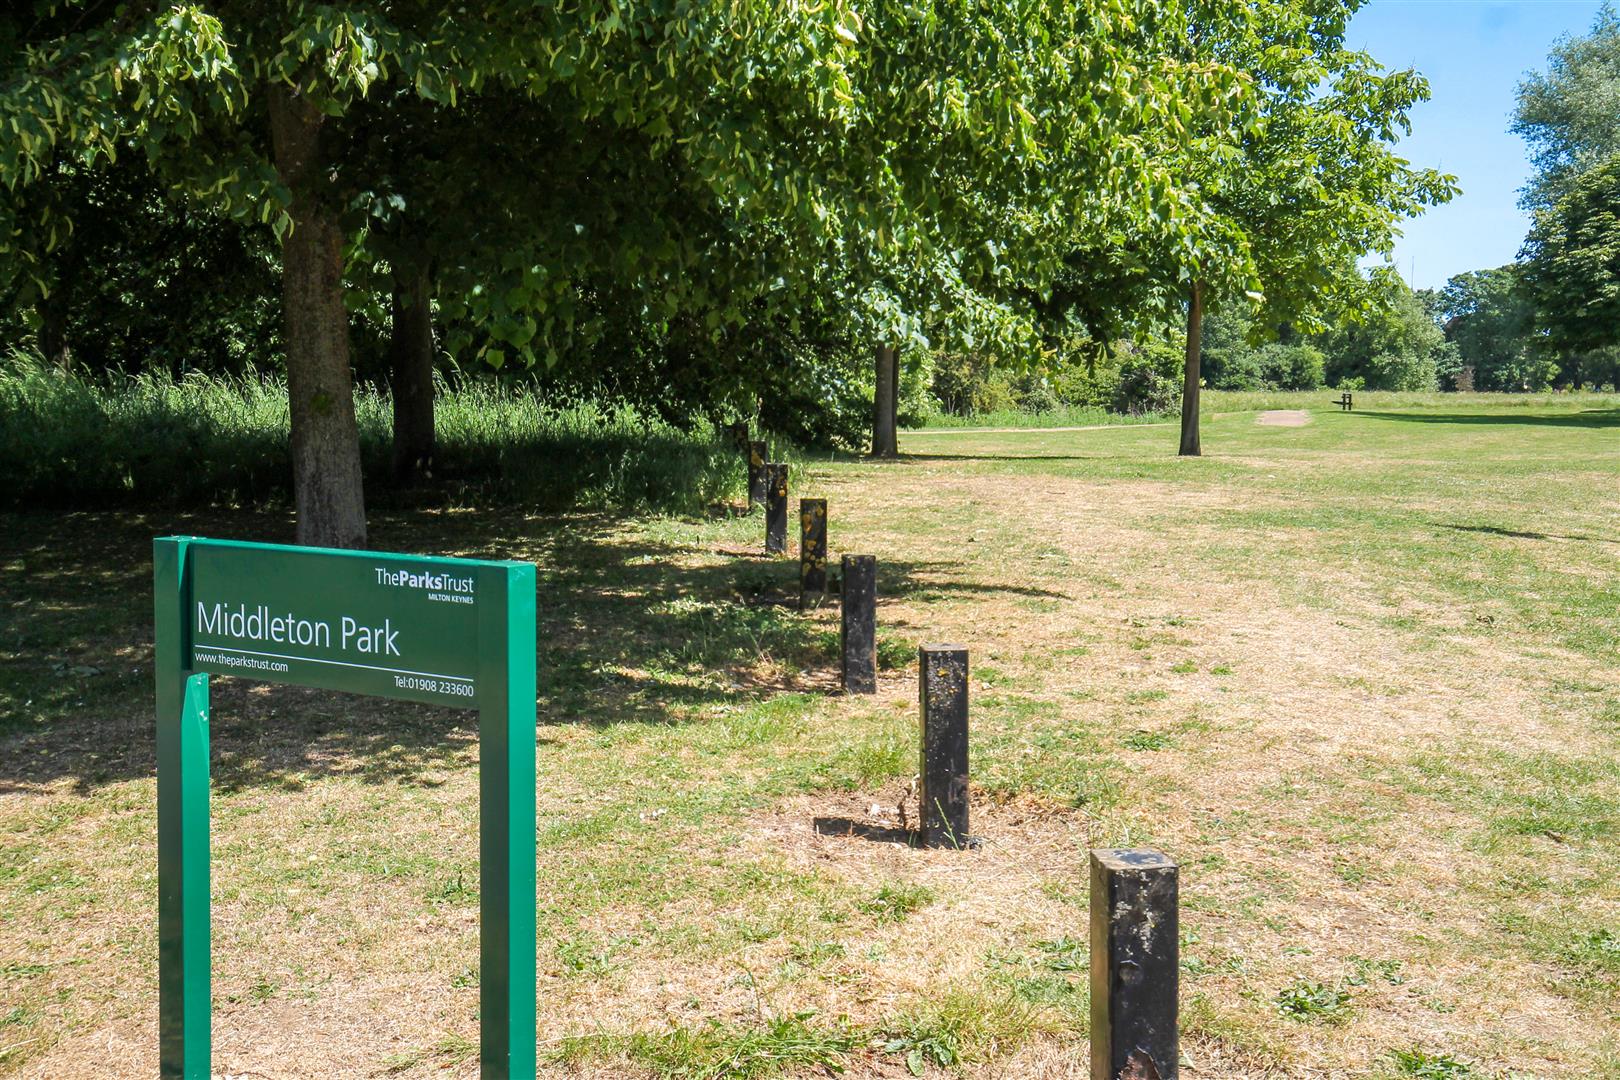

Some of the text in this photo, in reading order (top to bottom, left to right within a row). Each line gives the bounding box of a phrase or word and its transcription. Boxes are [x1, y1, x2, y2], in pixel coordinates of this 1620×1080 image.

[428, 593, 474, 604] MILTON KEYNES
[197, 601, 401, 656] Middleton Park
[195, 652, 289, 672] www.theparkstrust.com
[439, 681, 474, 697] 233600
